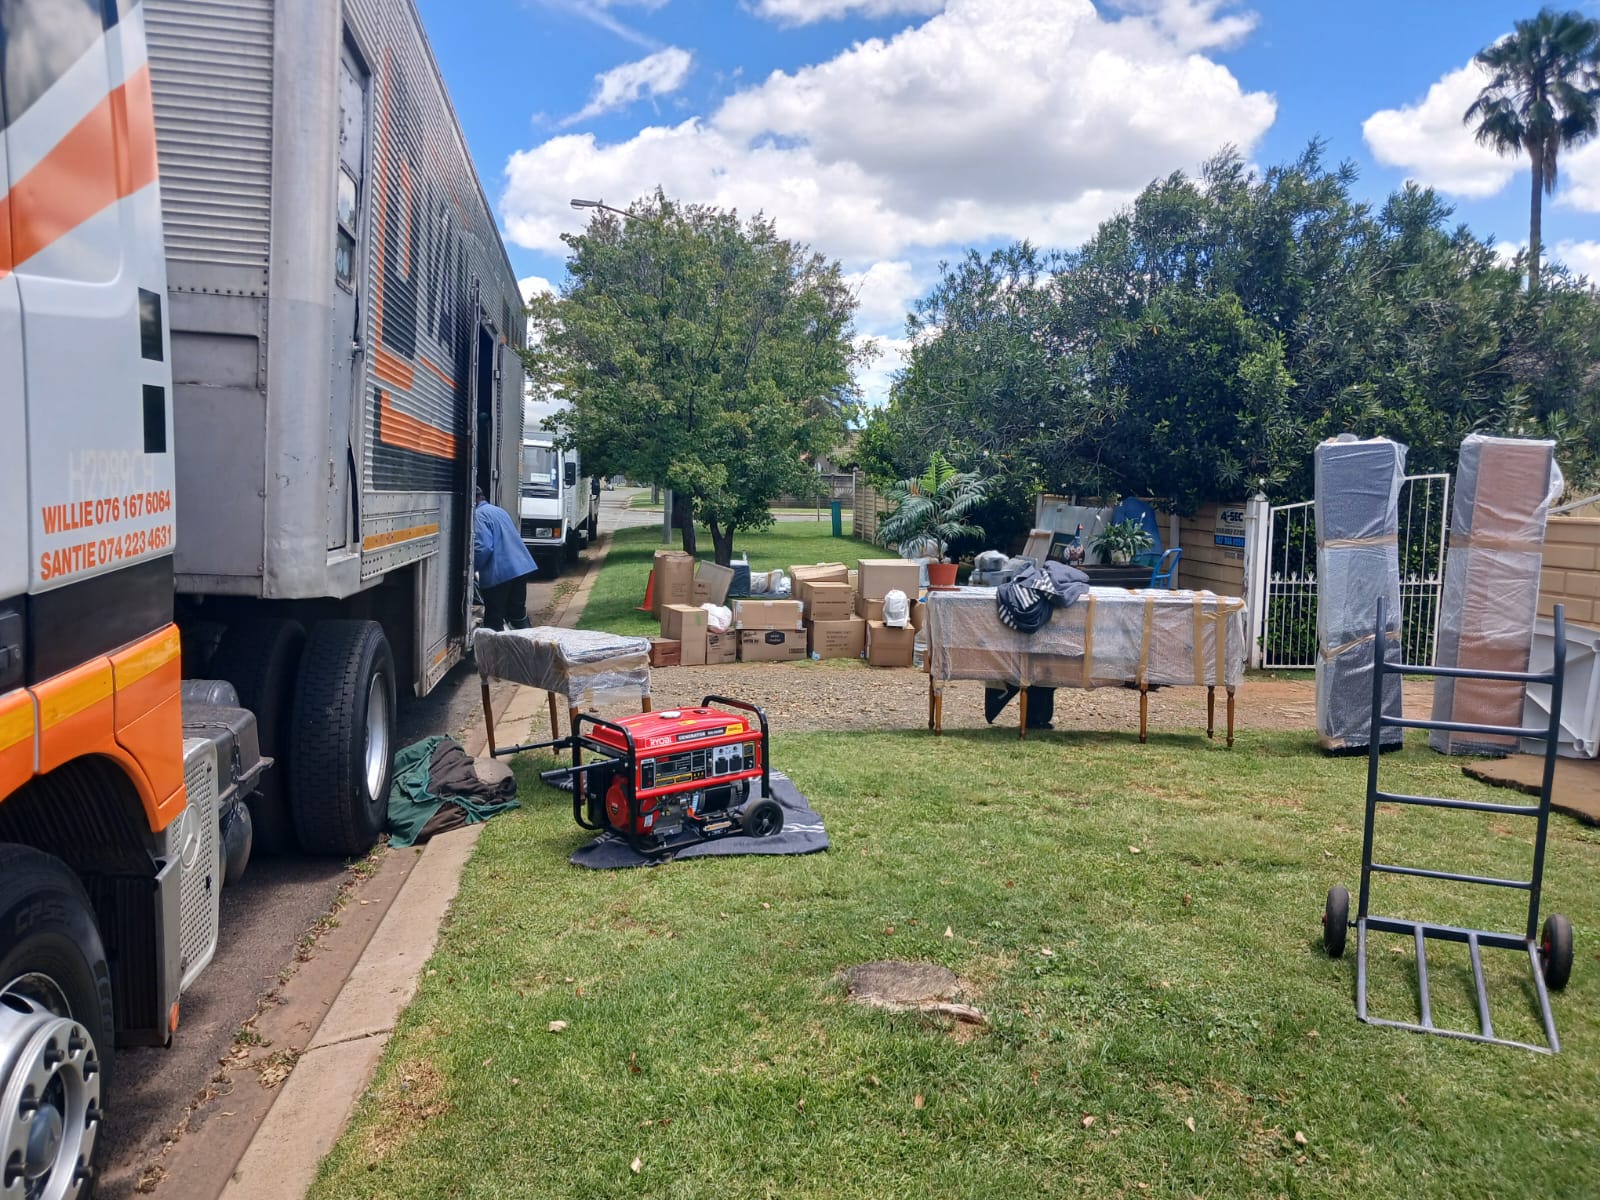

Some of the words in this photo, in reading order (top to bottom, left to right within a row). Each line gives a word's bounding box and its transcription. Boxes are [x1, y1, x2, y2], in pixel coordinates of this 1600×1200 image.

[42, 501, 93, 535] WILLIE
[95, 497, 120, 525] 076
[123, 494, 144, 520] 167
[145, 490, 171, 515] 6064
[40, 541, 96, 581] SANTIE
[98, 536, 122, 565] 074
[125, 530, 146, 558] 223
[148, 524, 172, 549] 4631
[650, 736, 672, 747] RYOBI
